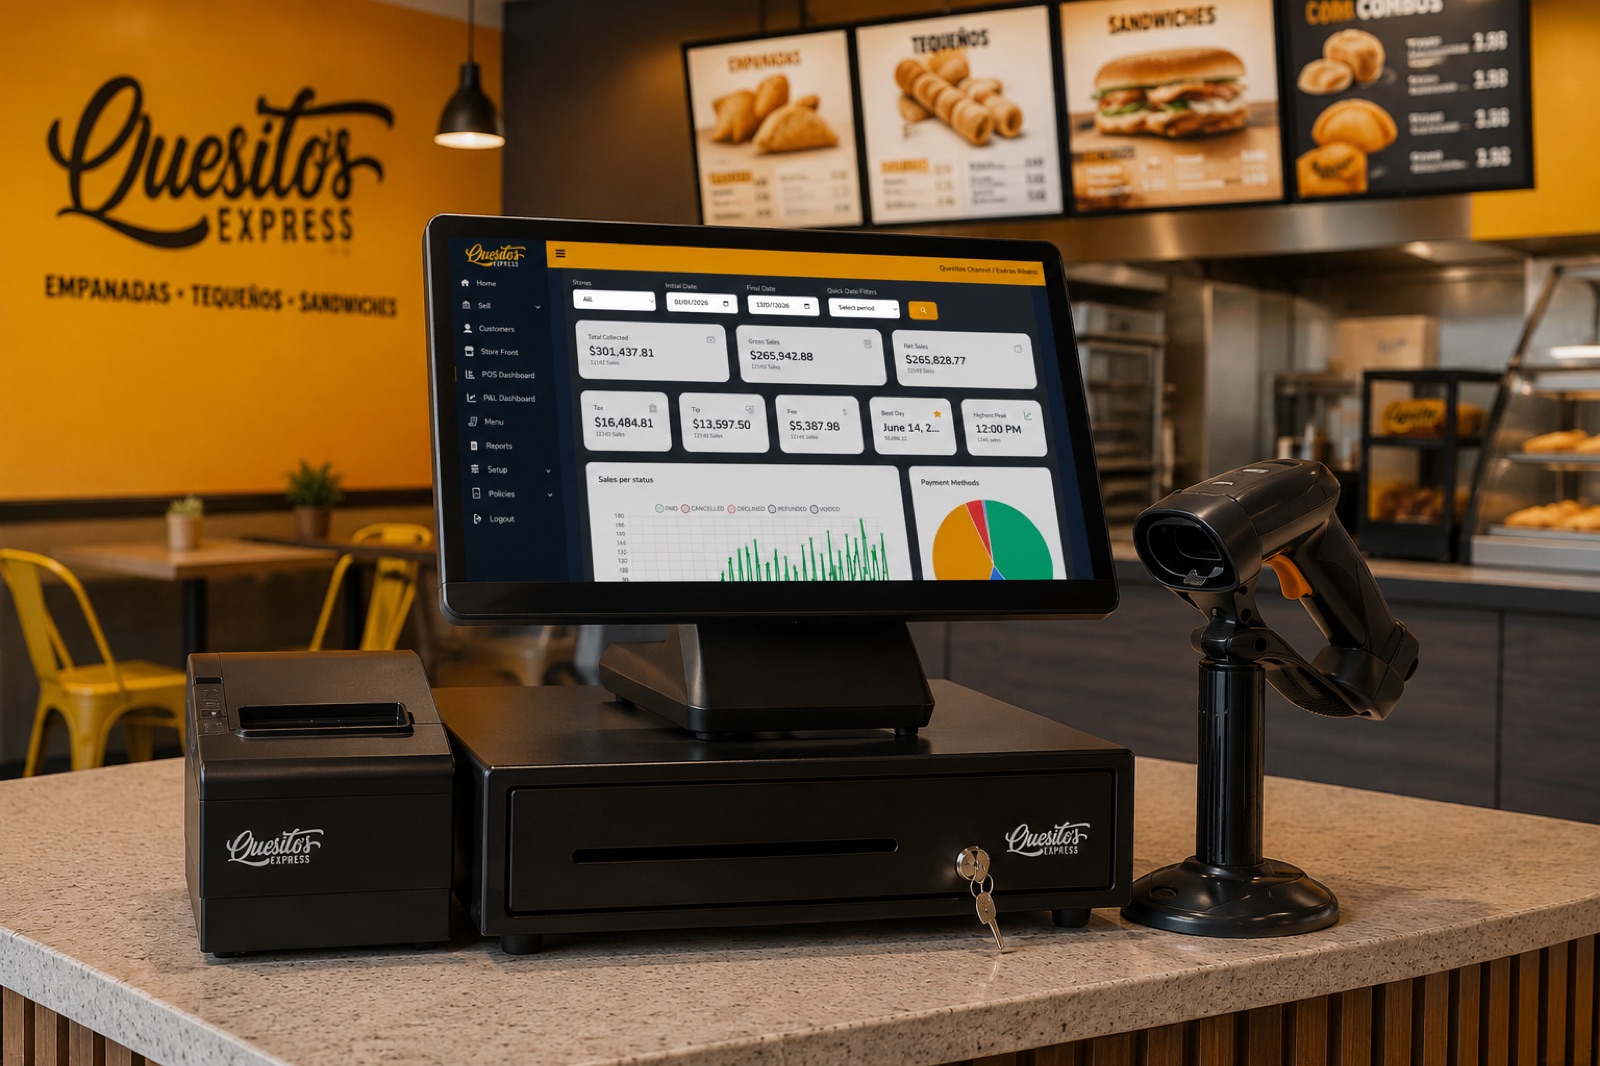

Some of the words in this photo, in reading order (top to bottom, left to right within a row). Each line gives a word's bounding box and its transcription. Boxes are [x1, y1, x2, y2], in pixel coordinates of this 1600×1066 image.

[1108, 6, 1216, 34] SANDWICHES
[912, 27, 989, 53] TEQUEÑOS
[218, 207, 354, 243] EXPRESS
[45, 274, 171, 304] EMPANADAS
[190, 283, 283, 311] TEQUEÑOS
[299, 291, 397, 317] SANDWICHES
[827, 287, 844, 295] Quick
[479, 325, 515, 333] Customers
[765, 338, 780, 346] Sales
[480, 348, 499, 356] Store
[500, 348, 519, 356] Front
[589, 345, 655, 358] $301,437.81
[750, 350, 813, 361] $265,942.88
[905, 355, 966, 365] $265,828.77
[482, 370, 498, 378] POS
[499, 371, 535, 379] Dashboard
[499, 395, 536, 403] Dashboard
[484, 418, 504, 426] Menu
[594, 416, 654, 429] $16,484.81
[693, 418, 751, 430] $13,597.50
[789, 420, 841, 432] $5,387.98
[882, 422, 905, 433] June
[908, 423, 923, 434] 14,
[975, 424, 1003, 434] 12:00
[1005, 424, 1022, 434] PM
[486, 442, 513, 451] Reports
[487, 466, 508, 475] Setup
[598, 475, 618, 483] Sales
[632, 476, 654, 484] status
[920, 479, 949, 487] Payment
[951, 479, 979, 487] Methods
[488, 490, 515, 498] Policies
[489, 515, 515, 524] Logout
[1044, 846, 1078, 855] EXPRESS
[270, 855, 310, 865] EXPRESS
